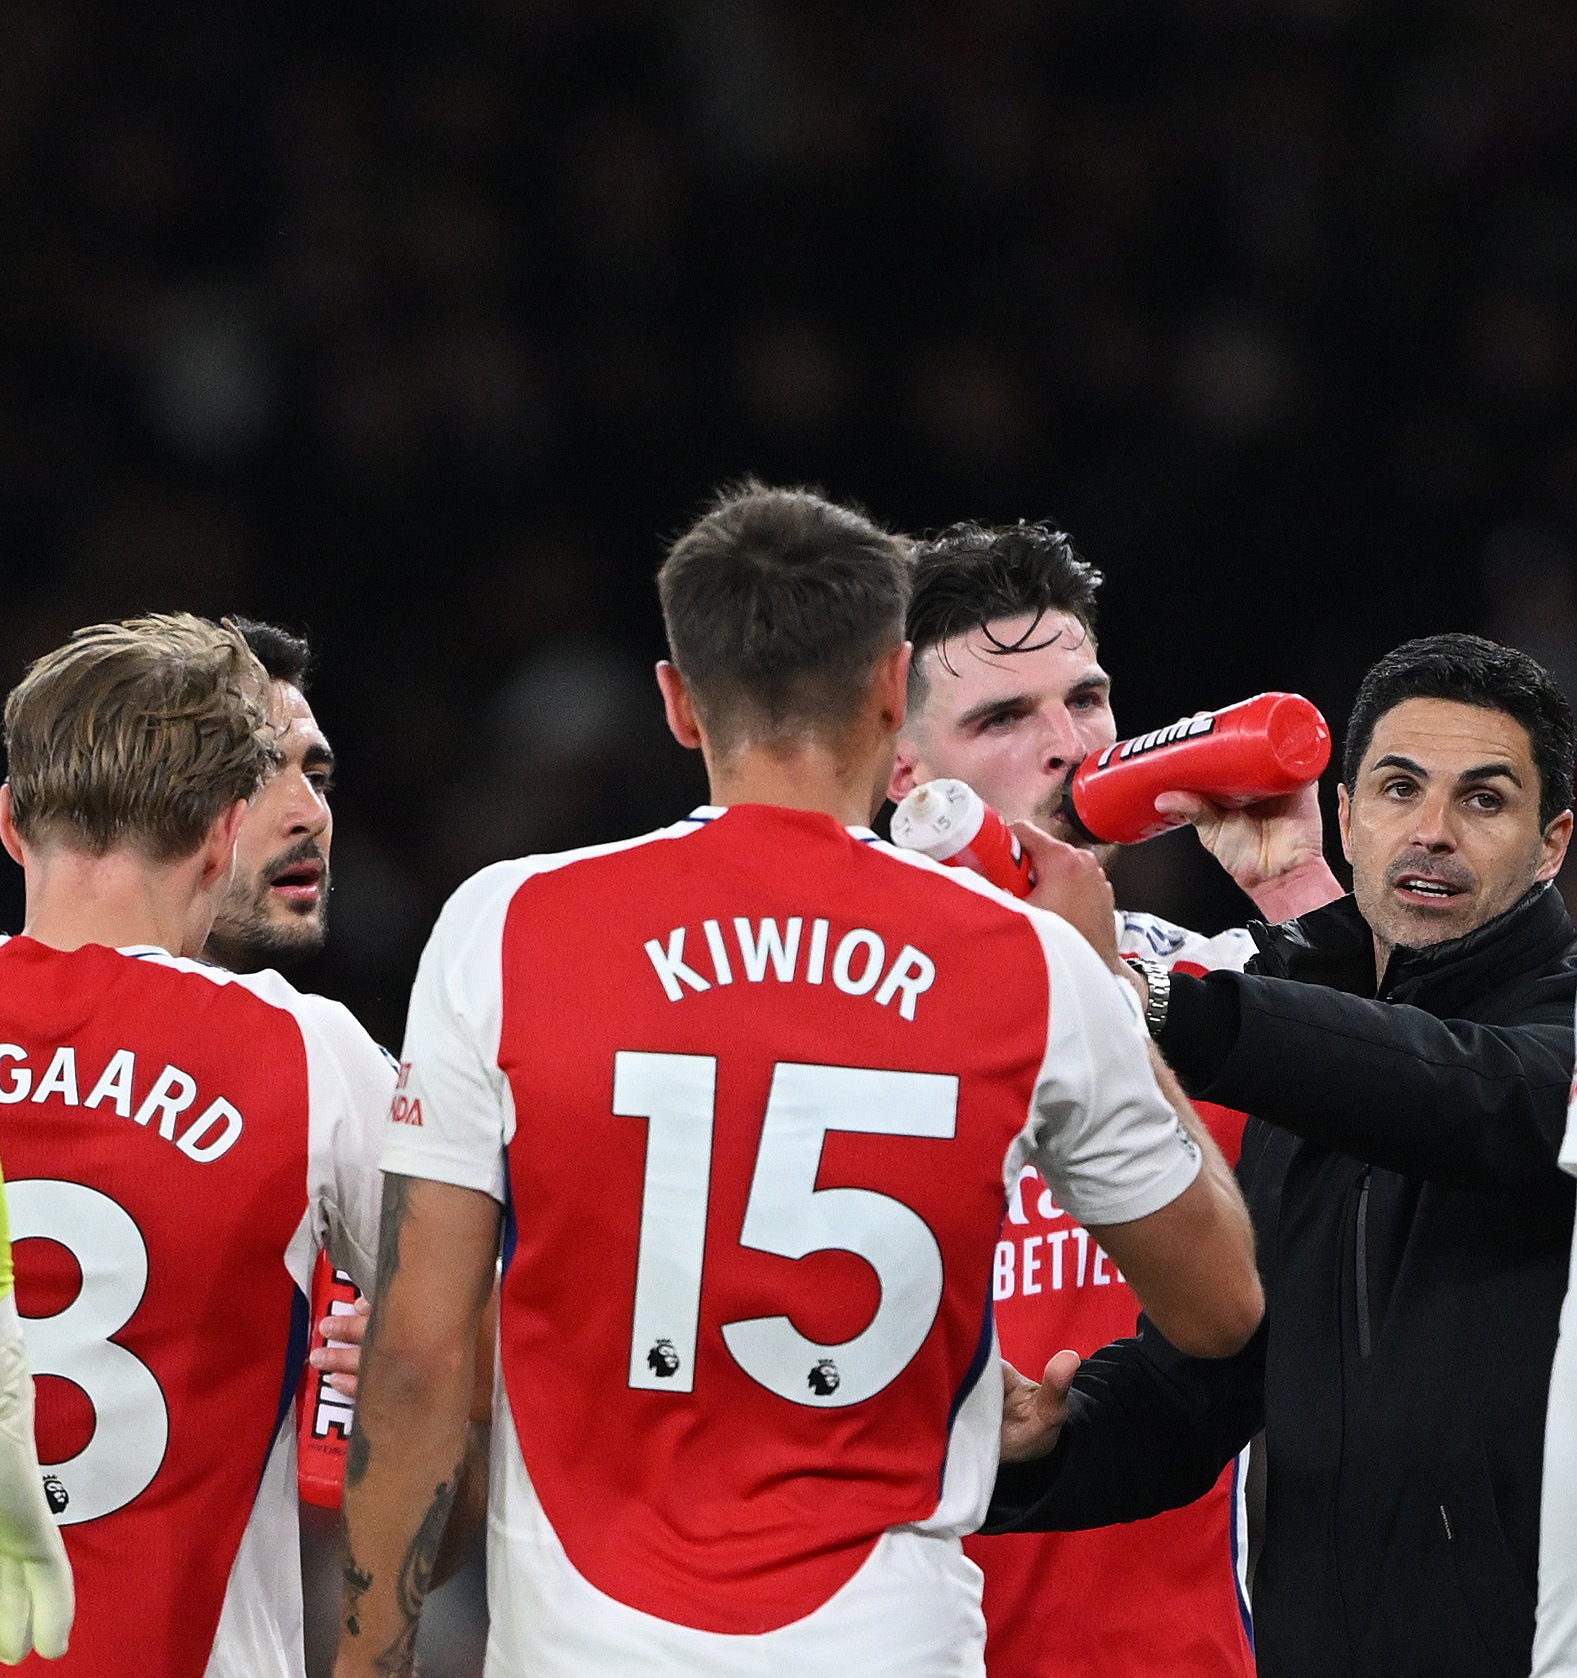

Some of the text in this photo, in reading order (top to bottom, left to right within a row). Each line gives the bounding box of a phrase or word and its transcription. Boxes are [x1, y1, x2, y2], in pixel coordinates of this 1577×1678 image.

[645, 917, 936, 1021] KIWIOR
[612, 1050, 959, 1408] 15
[993, 1227, 1127, 1301] BETTE
[3, 1178, 170, 1527] 8
